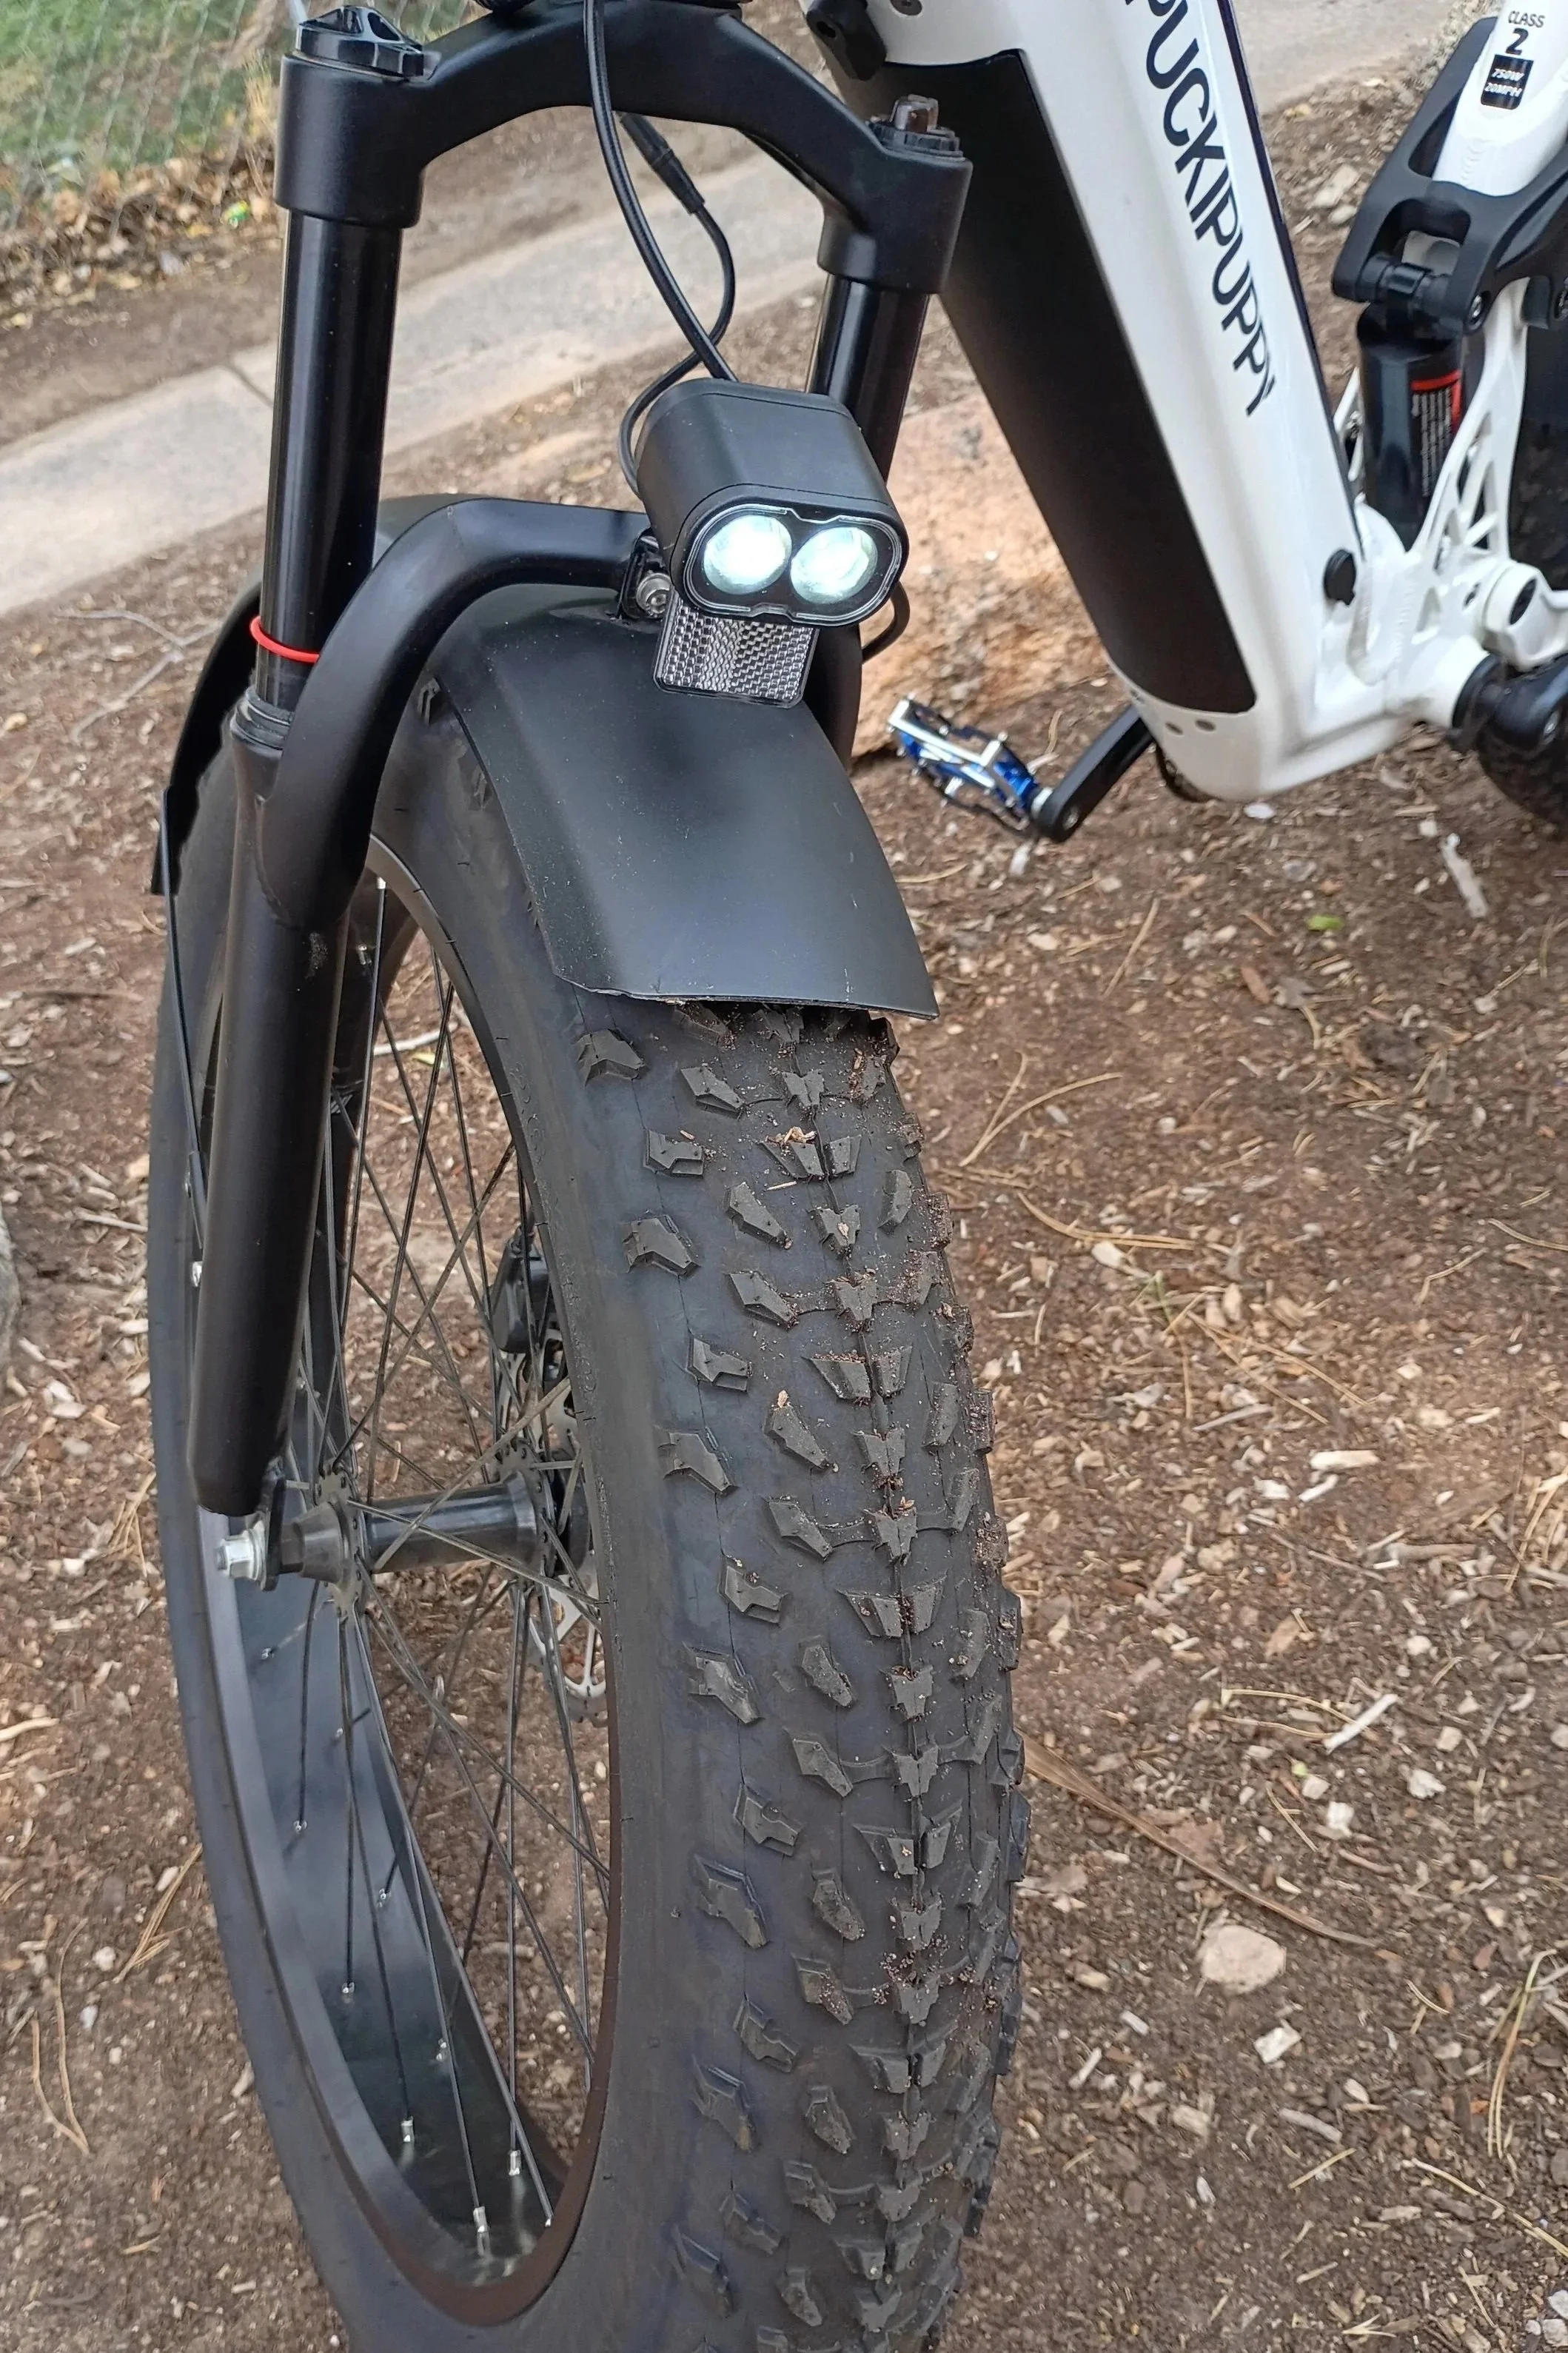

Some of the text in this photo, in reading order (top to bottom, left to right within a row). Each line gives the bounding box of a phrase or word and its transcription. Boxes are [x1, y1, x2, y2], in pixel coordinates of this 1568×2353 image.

[1508, 10, 1545, 28] CLASS
[1505, 27, 1529, 56] 2
[1125, 0, 1275, 416] UCKIPUPPY
